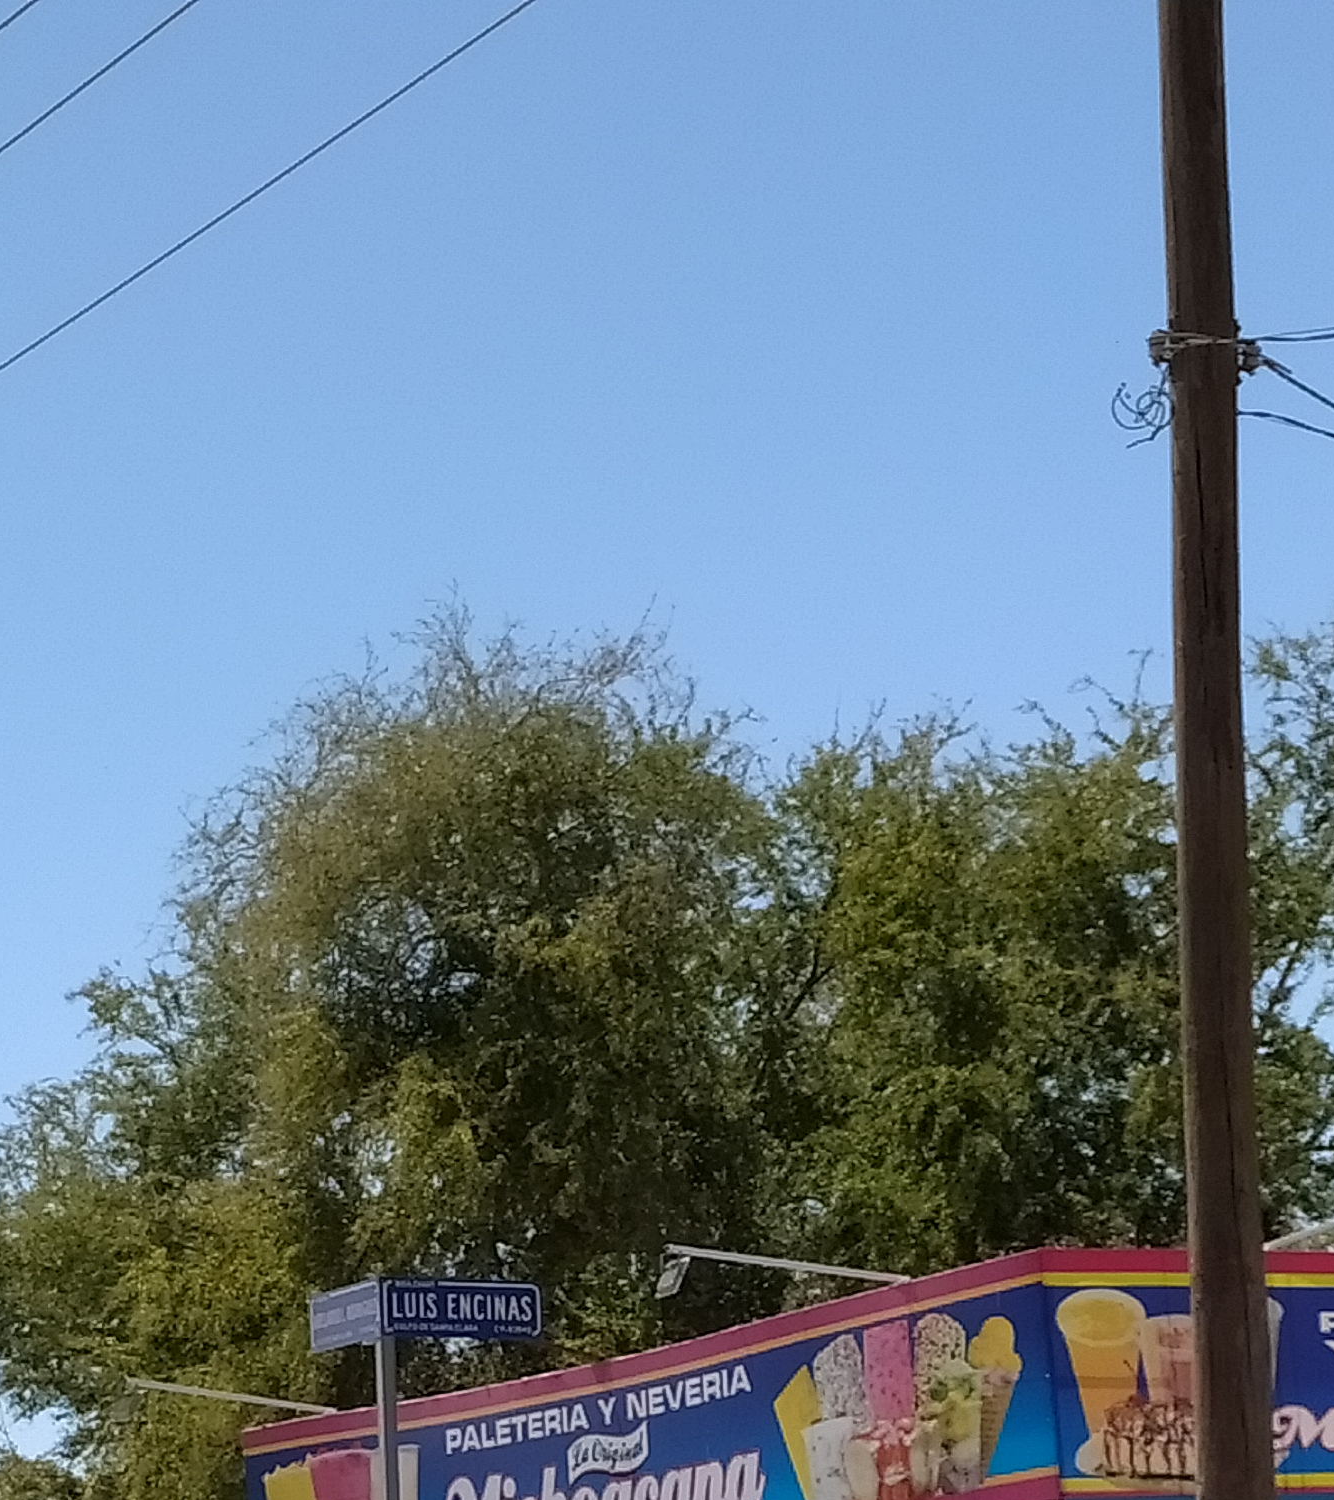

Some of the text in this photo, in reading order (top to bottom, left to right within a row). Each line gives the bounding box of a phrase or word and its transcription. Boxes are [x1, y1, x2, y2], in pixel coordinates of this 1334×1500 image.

[391, 1292, 438, 1319] LUIS
[446, 1293, 533, 1322] ENCINAS
[444, 1364, 753, 1455] PALETERIA Y NEVERIA
